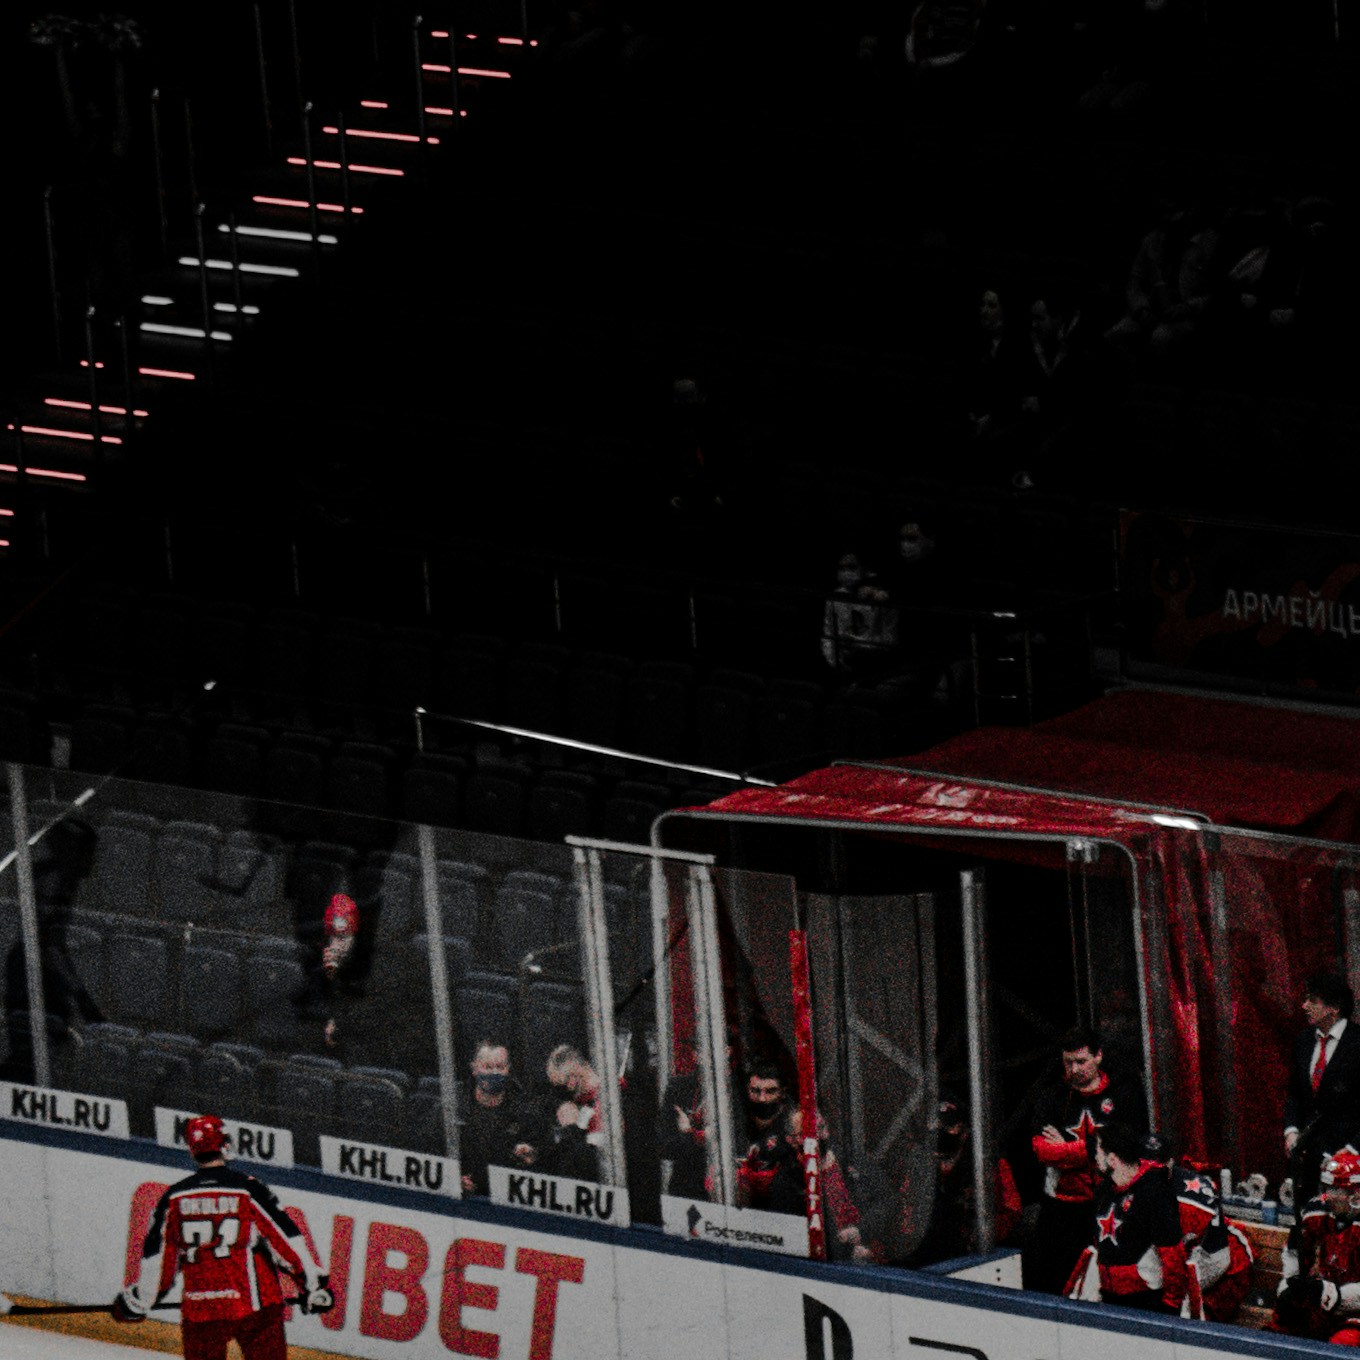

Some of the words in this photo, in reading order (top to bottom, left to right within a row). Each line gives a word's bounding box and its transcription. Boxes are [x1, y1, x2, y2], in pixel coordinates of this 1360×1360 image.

[12, 1088, 111, 1131] KHL.RU
[339, 1143, 443, 1190] KHL.RU
[508, 1172, 614, 1220] KHL.RU
[181, 1216, 241, 1264] 71
